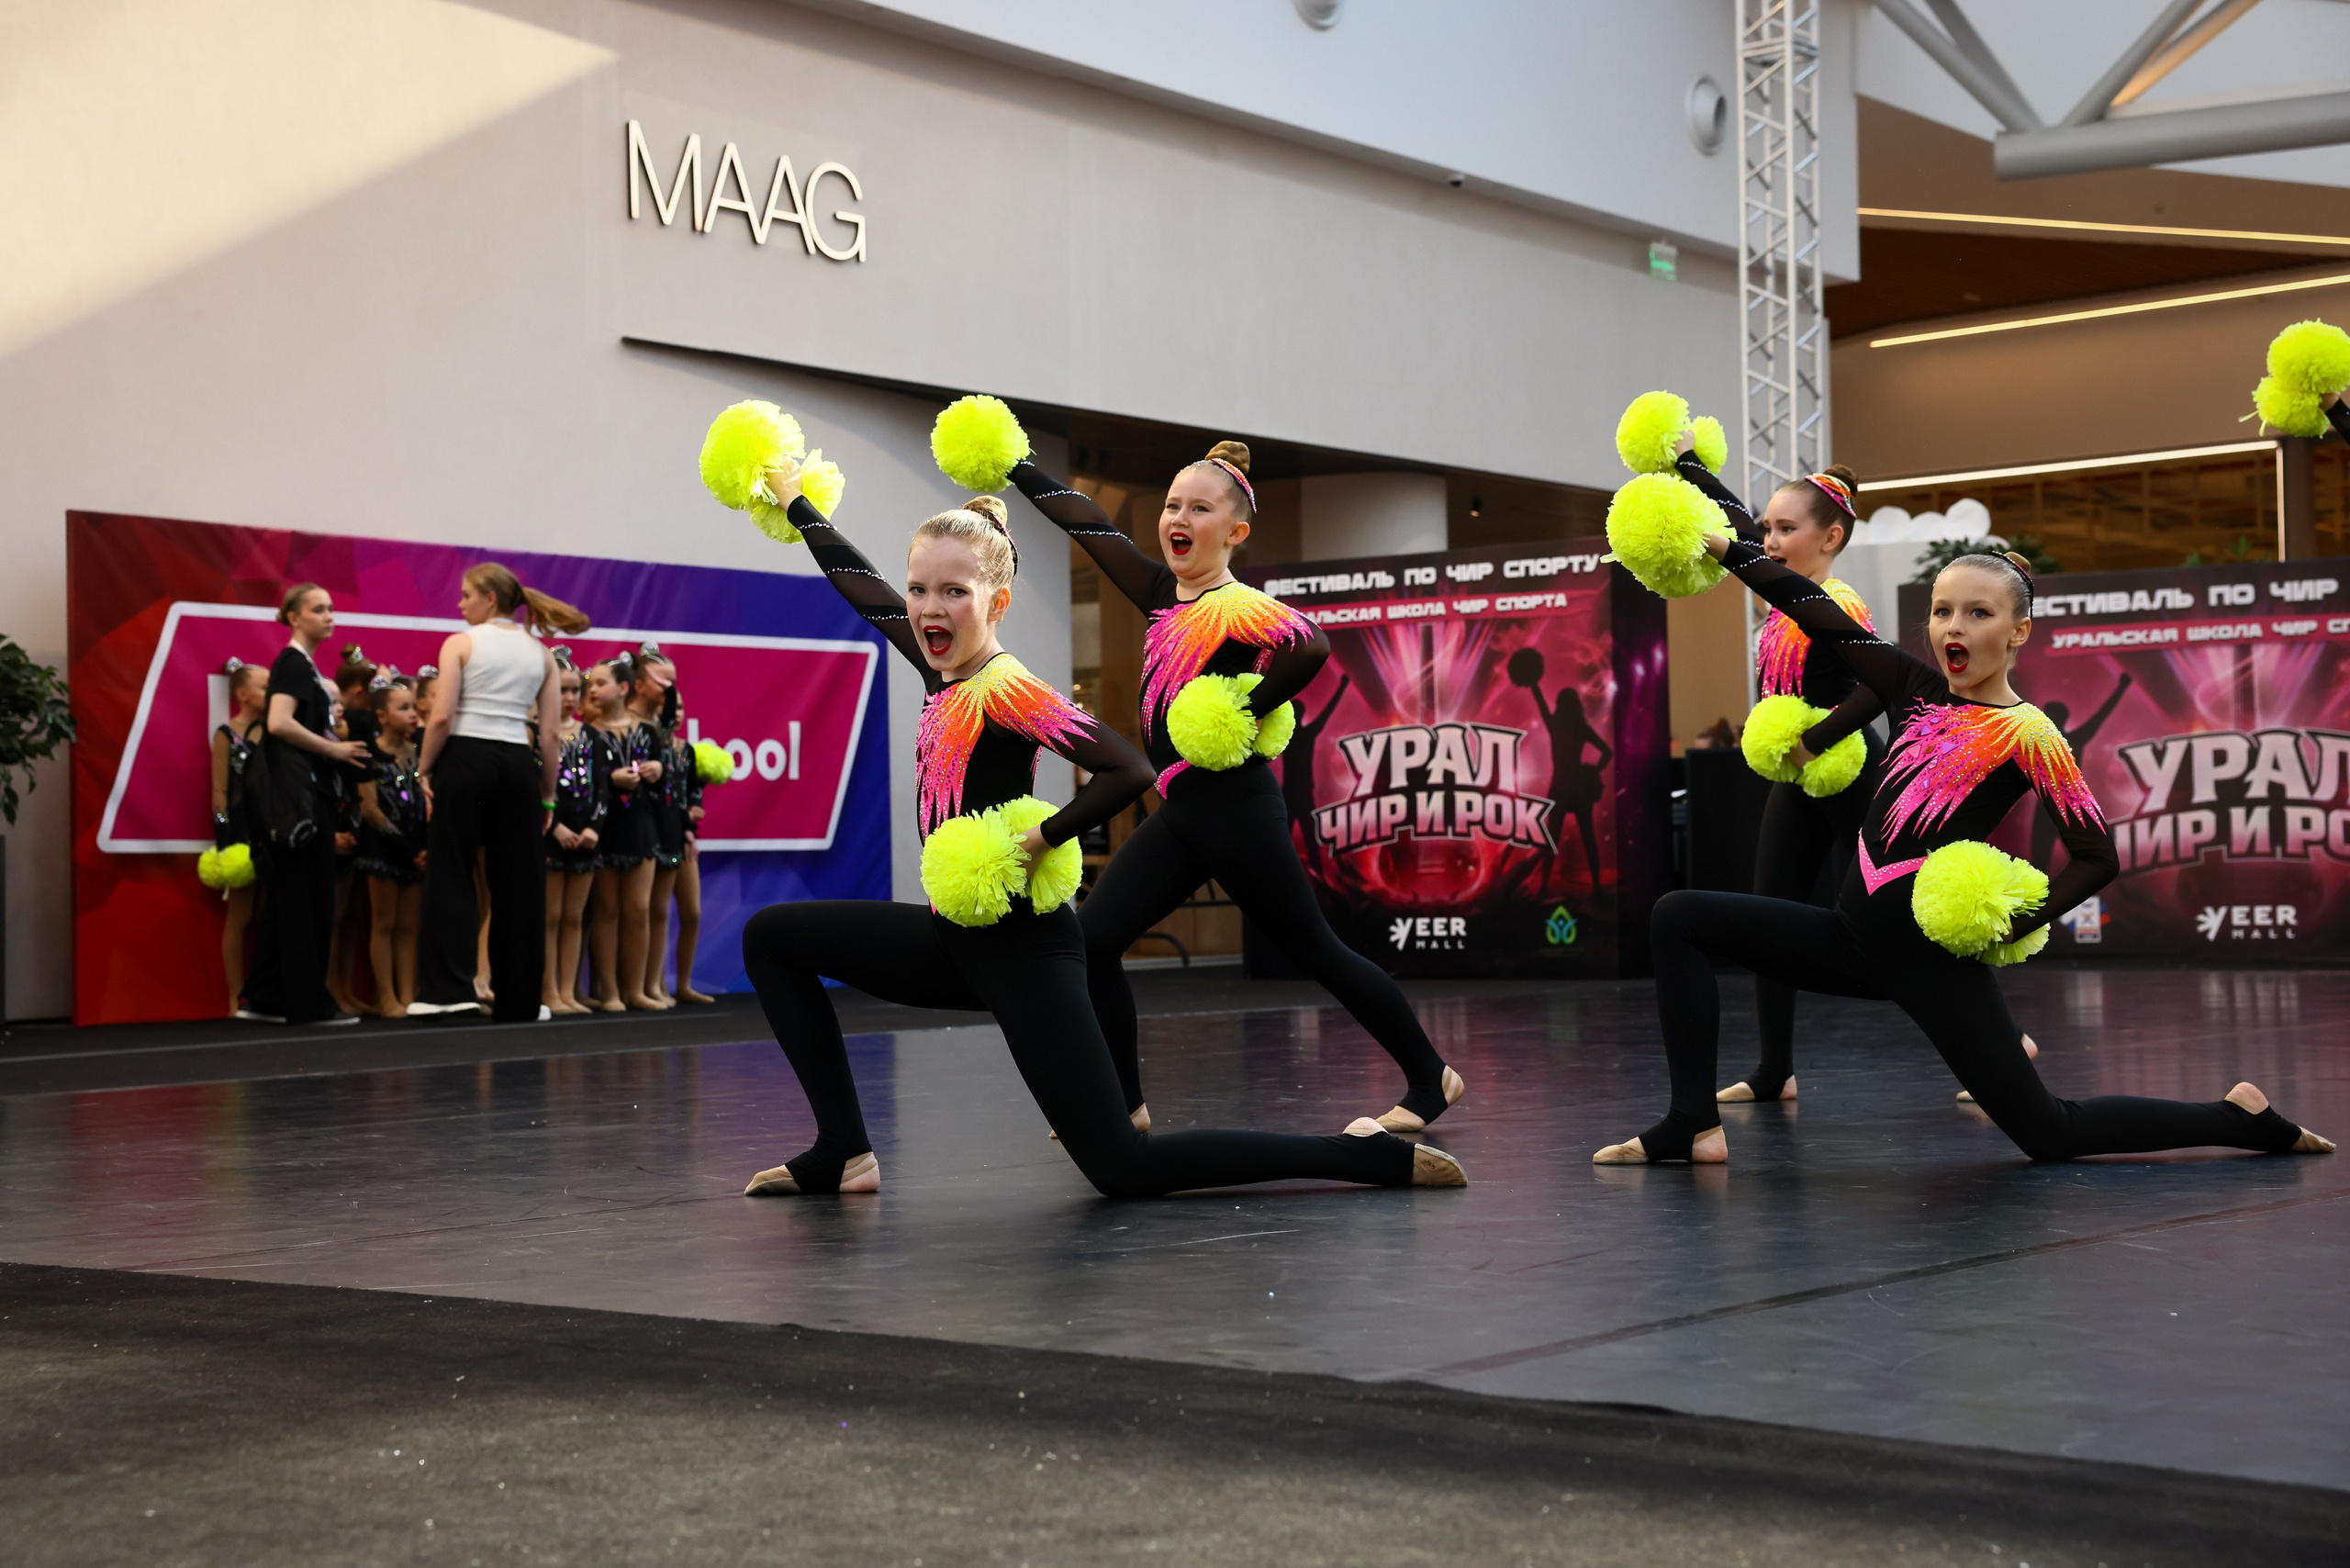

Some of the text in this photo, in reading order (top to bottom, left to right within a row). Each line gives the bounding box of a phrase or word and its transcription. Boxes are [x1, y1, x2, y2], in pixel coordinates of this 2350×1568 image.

[628, 118, 867, 263] MAAG
[1264, 553, 1599, 597] ФЕСТИВАЛЬ ПО ЧИР СПОРТУ
[1305, 593, 1568, 625] АЛЬСКАЯ ШКОЛА ЧИР СПОРТА
[2032, 577, 2339, 618] ЕСТИВАЛЬ ПО ЧИР
[2053, 628, 2178, 649] УРАЛЬСКАЯ
[2187, 622, 2263, 642] ШКОЛА
[2271, 620, 2318, 637] ЧИР
[1342, 726, 1517, 798] УРАЛ
[1319, 790, 1547, 851] ЧИР И РОК
[2230, 805, 2271, 855] И
[2285, 805, 2350, 856] РО
[1416, 940, 1465, 949] MALL
[2232, 928, 2296, 939] MALL
